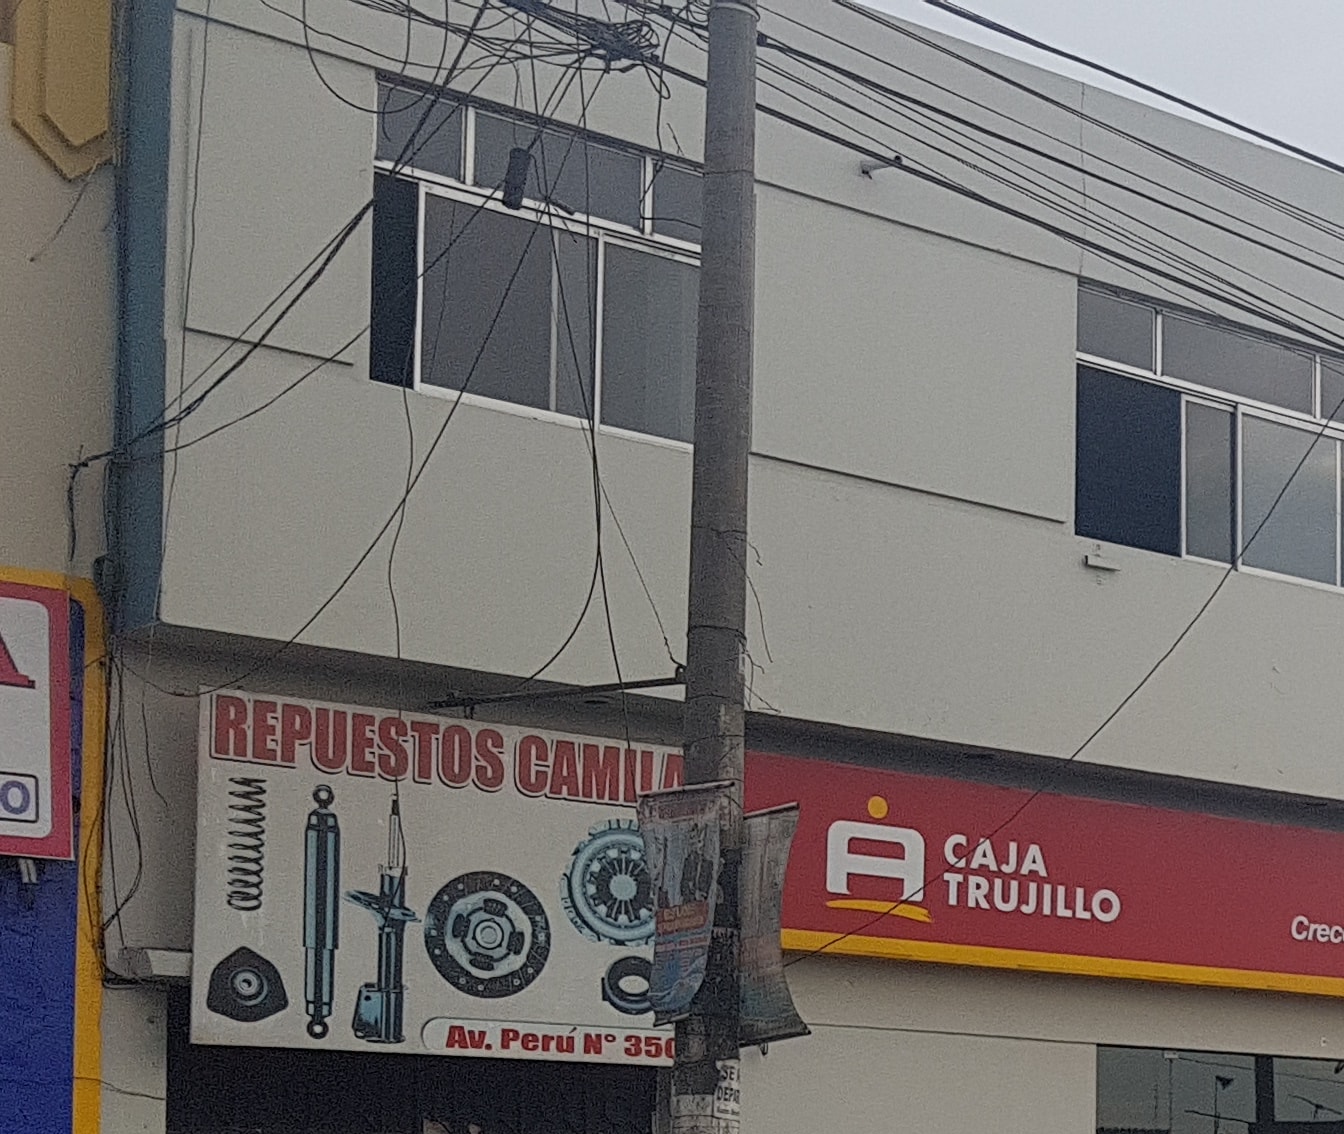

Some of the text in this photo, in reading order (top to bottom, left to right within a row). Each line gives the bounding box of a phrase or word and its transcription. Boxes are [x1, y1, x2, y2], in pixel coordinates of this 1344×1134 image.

[212, 695, 505, 790] REPUESTOS
[944, 834, 1048, 877] CAJA
[943, 872, 1121, 922] TRUJILLO
[446, 1025, 492, 1050] Av.
[501, 1026, 576, 1053] Perú
